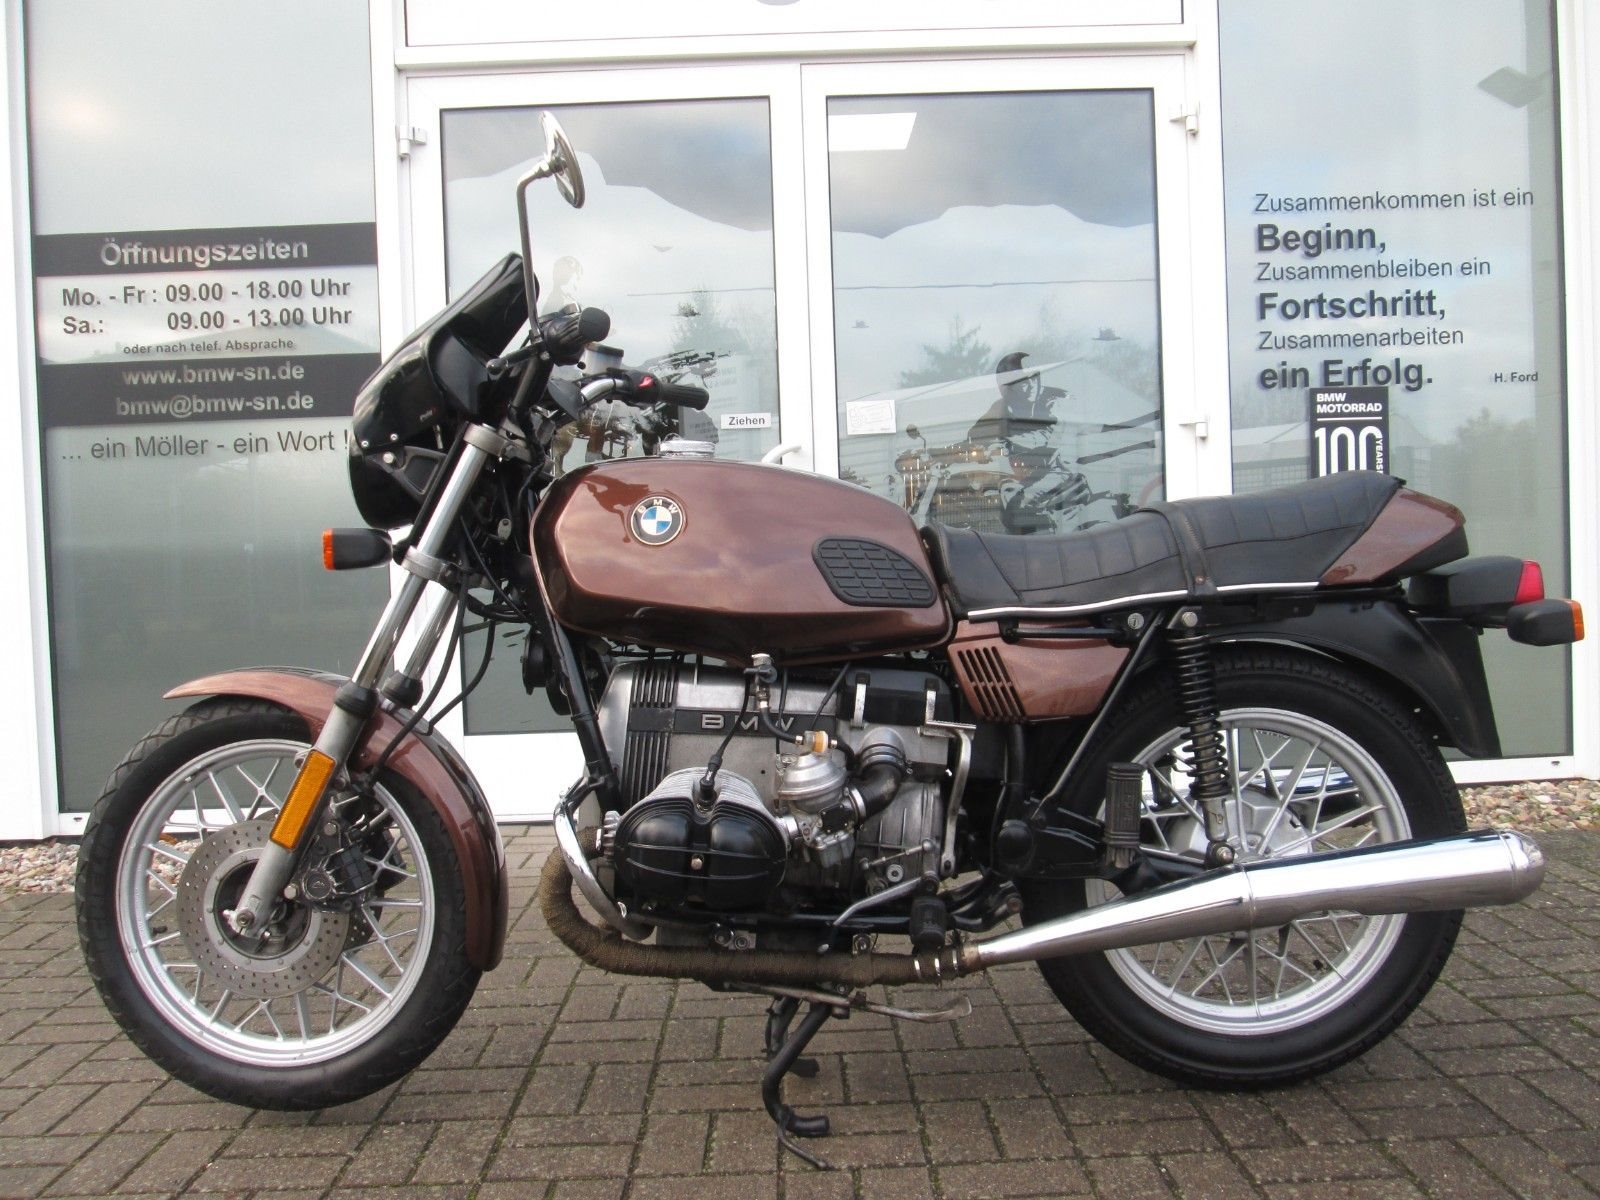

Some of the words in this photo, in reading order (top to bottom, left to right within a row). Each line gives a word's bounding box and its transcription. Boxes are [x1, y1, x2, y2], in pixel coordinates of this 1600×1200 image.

[1255, 190, 1465, 213] Zusammenkommen
[1473, 188, 1497, 207] ist
[1504, 188, 1534, 206] ein
[1257, 222, 1386, 258] Beginn,
[100, 238, 308, 267] Öffnungszeiten
[1257, 259, 1452, 281] Zusammenbleiben
[1460, 258, 1491, 276] ein
[62, 288, 101, 306] Mo.
[165, 283, 223, 302] 09.00
[246, 280, 302, 300] 18.00
[311, 279, 350, 297] Uhr
[1259, 289, 1446, 321] Fortschritt,
[63, 316, 103, 335] Sa.:
[168, 312, 225, 331] 09.00
[248, 308, 304, 328] 13.00
[312, 307, 352, 325] Uhr
[123, 344, 152, 355] oder
[156, 342, 187, 353] nach
[191, 340, 221, 352] telef.
[226, 338, 294, 352] Absprache
[1258, 328, 1464, 350] Zusammenarbeiten
[122, 361, 305, 385] www.bmw-sn.de
[1260, 361, 1310, 389] ein
[1323, 358, 1433, 392] Erfolg.
[1494, 373, 1507, 383] H.
[1511, 372, 1538, 383] Ford
[116, 391, 314, 418] bmw@bmw-sn.de
[1317, 392, 1347, 402] BMW
[1317, 403, 1382, 413] MOTORRAD
[729, 416, 765, 426] Ziehen
[91, 439, 126, 459] ein
[135, 435, 208, 457] Möller
[233, 435, 268, 454] ein
[278, 431, 334, 453] Wort
[638, 499, 679, 514] BMW
